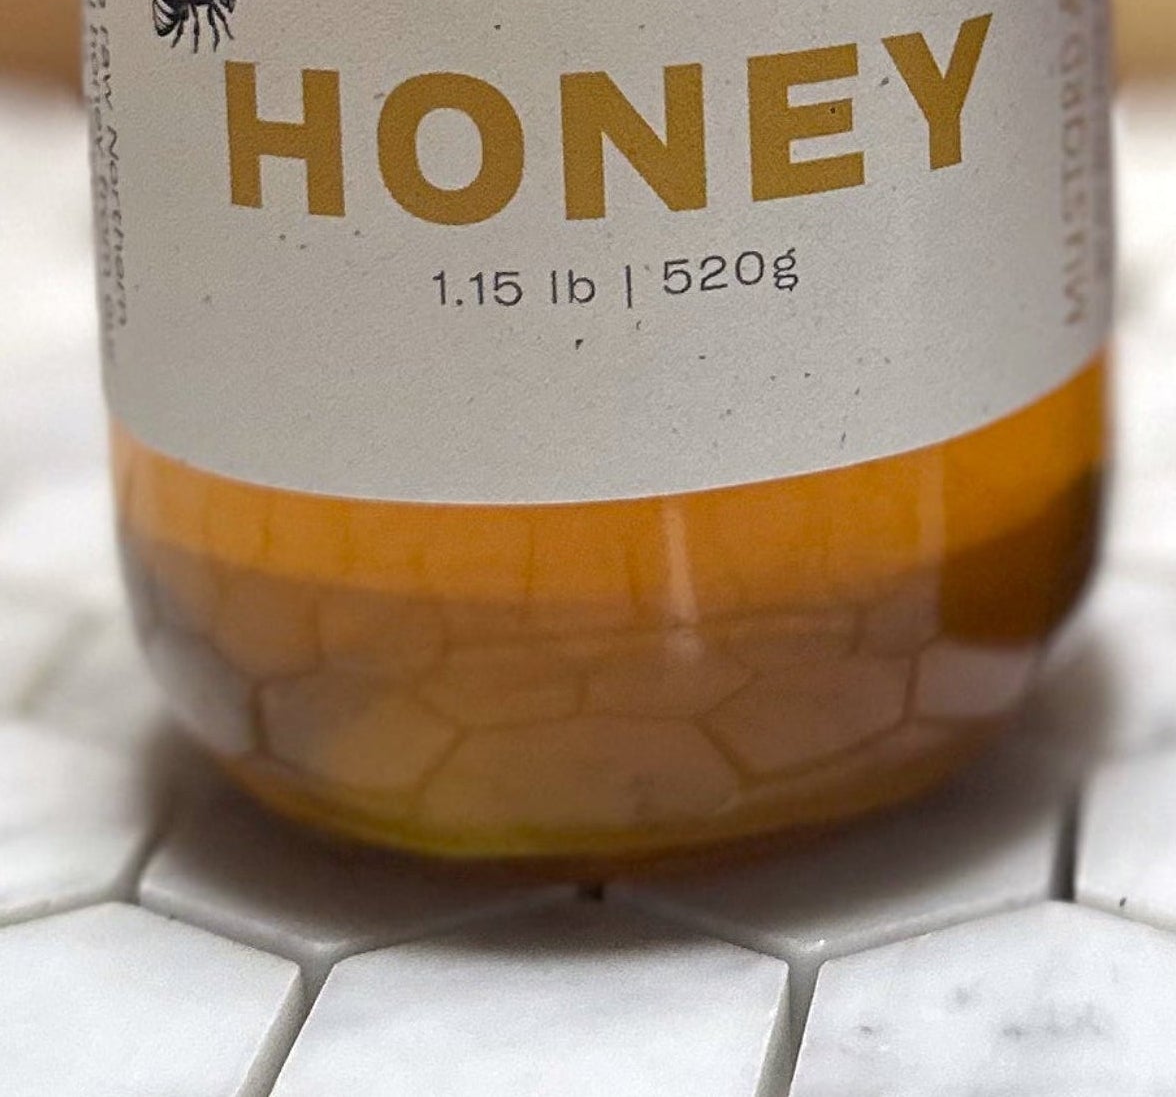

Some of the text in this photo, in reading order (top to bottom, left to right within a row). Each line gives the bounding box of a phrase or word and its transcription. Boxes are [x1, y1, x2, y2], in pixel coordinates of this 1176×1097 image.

[100, 23, 114, 111] raw
[225, 13, 993, 226] HONEY
[106, 125, 128, 327] Northern
[432, 269, 524, 307] 1.15
[550, 268, 597, 305] lb
[662, 246, 800, 296] 520g
